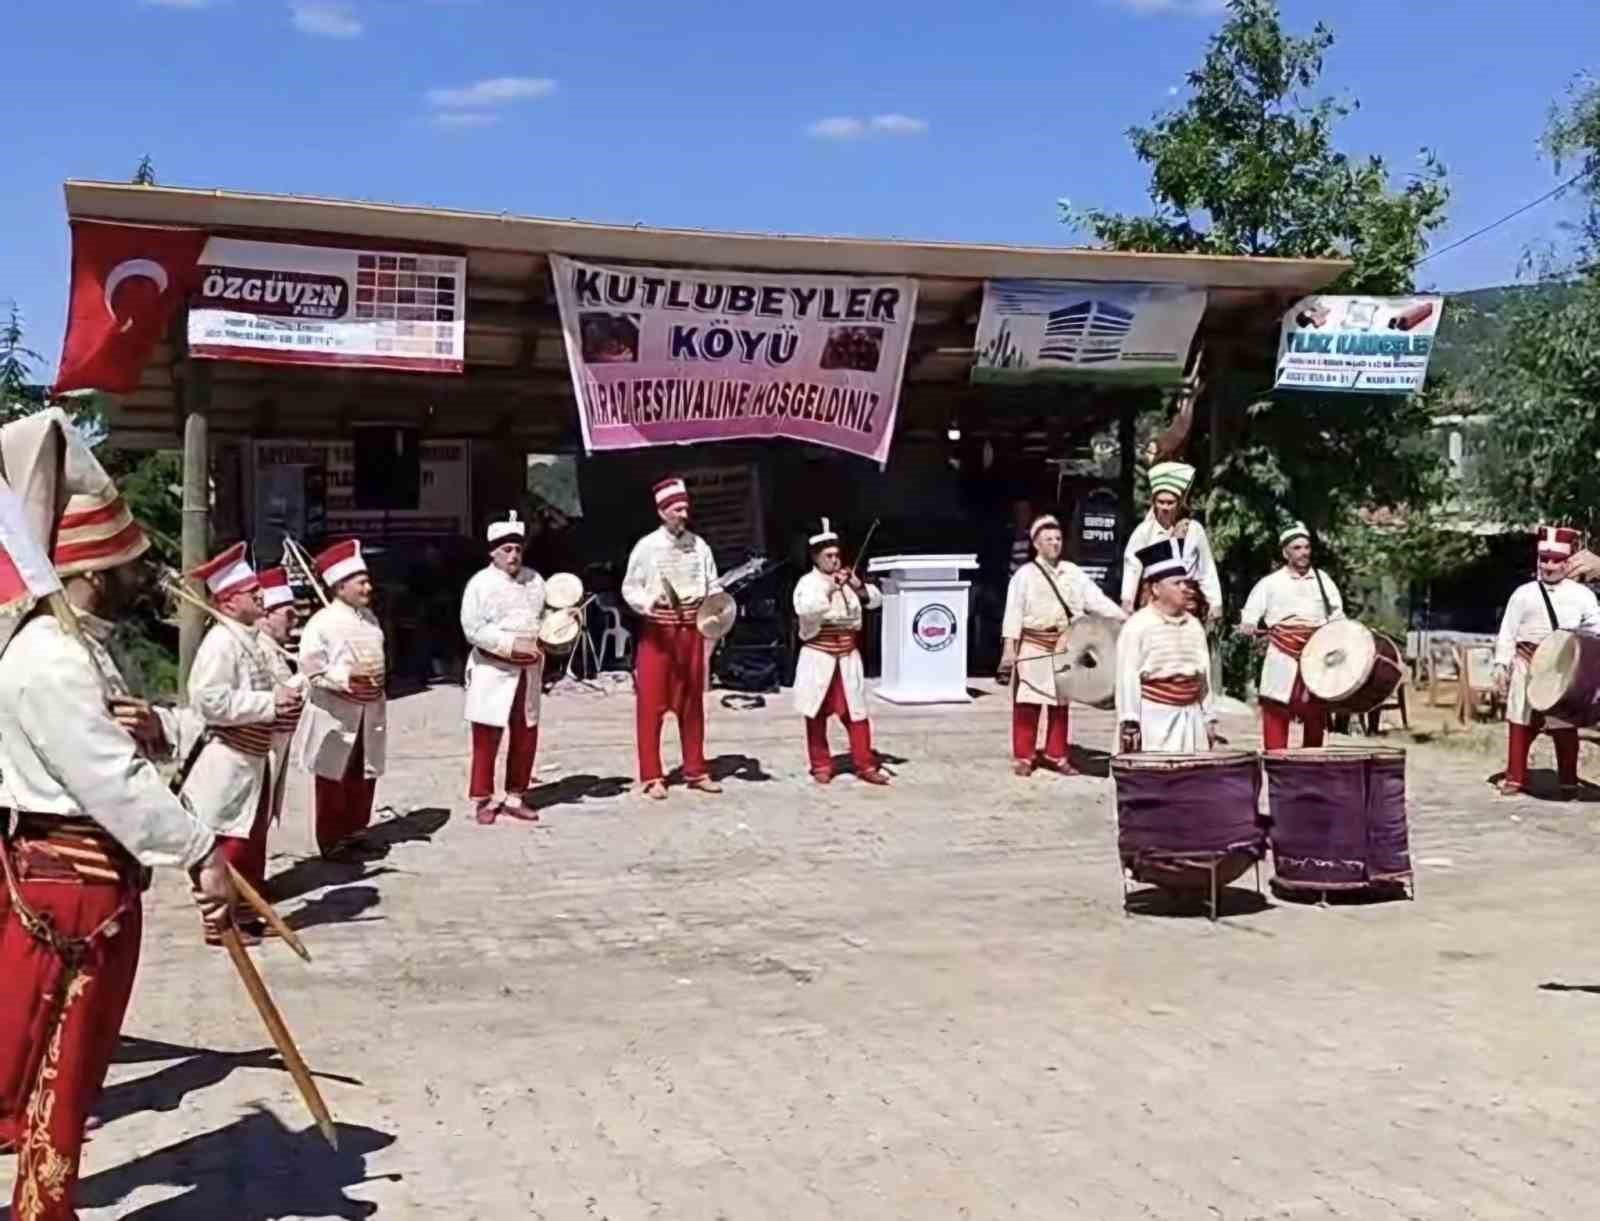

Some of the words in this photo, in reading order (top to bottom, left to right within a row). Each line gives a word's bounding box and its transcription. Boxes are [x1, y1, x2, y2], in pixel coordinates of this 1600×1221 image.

[202, 267, 343, 307] ÖZGÜVEN
[573, 268, 900, 322] KUTLUBEYLER
[668, 318, 800, 367] KÖYÜ
